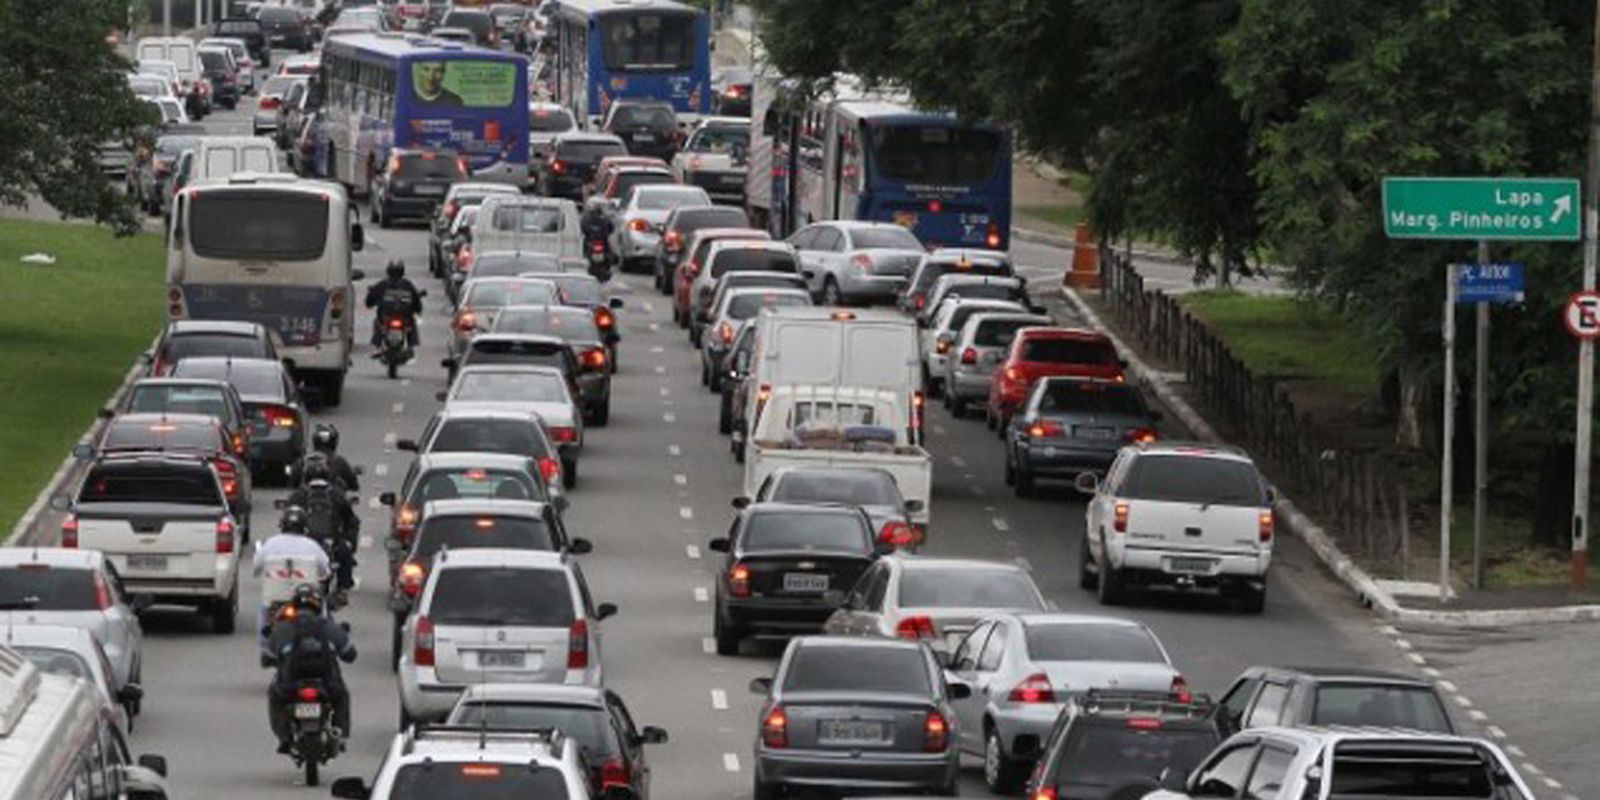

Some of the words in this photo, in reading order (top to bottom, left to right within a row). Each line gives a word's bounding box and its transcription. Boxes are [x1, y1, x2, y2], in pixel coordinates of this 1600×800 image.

[1495, 188, 1544, 207] Lapa
[1390, 209, 1441, 231] Marg.
[1449, 209, 1544, 229] Pinheiros
